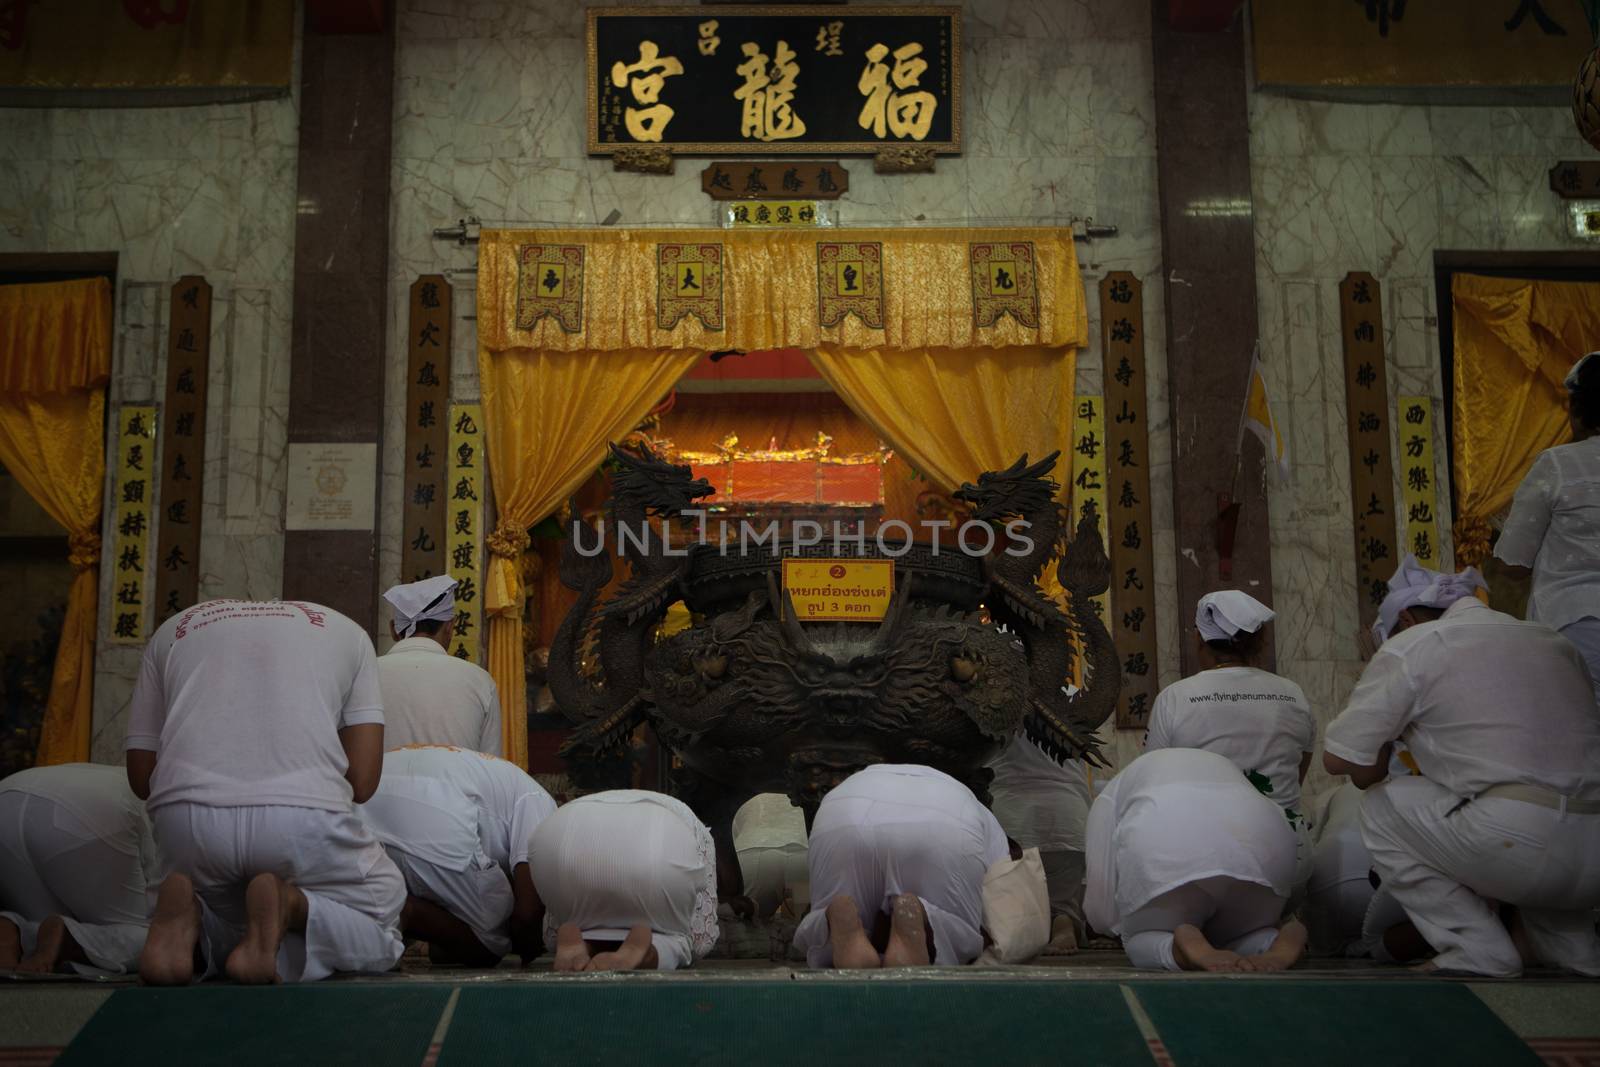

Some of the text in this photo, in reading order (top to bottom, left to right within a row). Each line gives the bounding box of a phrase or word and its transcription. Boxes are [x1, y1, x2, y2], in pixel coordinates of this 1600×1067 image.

[830, 602, 840, 613] 3
[844, 603, 872, 613] ดอก
[1188, 691, 1298, 704] www.flyinghanuman.com
